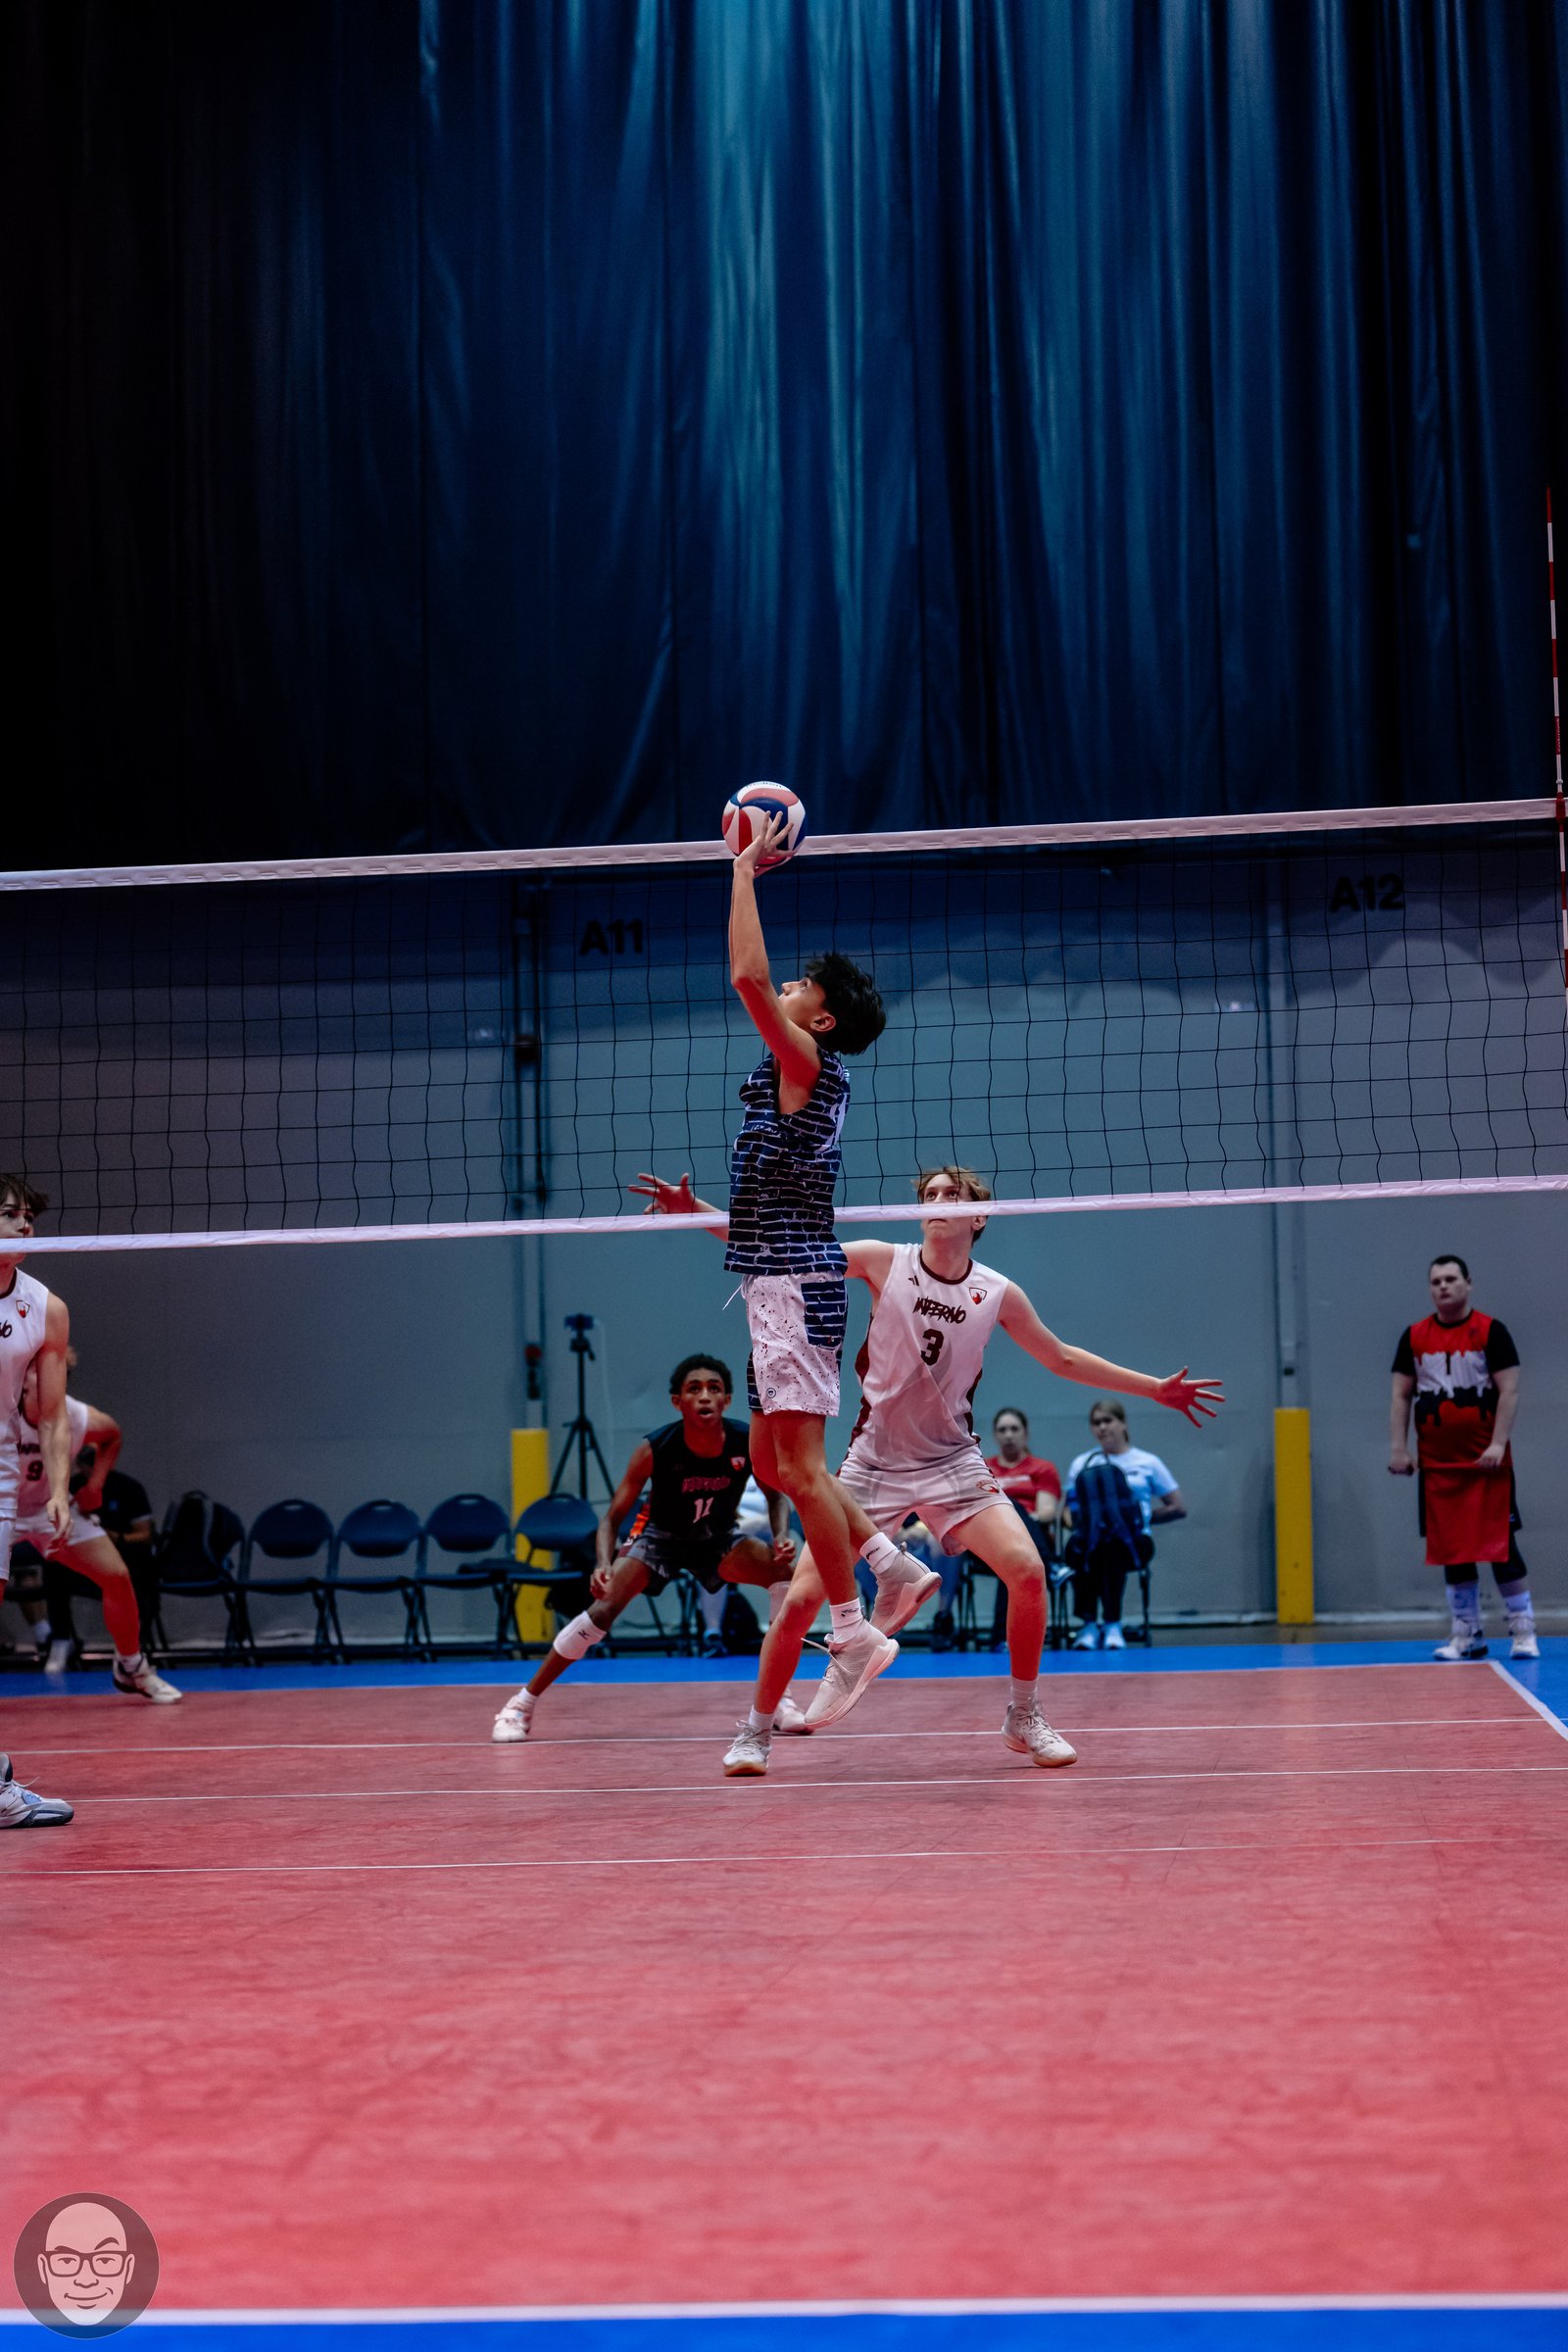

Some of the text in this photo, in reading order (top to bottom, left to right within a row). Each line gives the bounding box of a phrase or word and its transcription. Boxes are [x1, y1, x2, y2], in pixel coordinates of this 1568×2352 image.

[1330, 873, 1404, 912] A12
[579, 919, 643, 956] A11
[921, 1328, 944, 1366] 3
[25, 1459, 44, 1482] 9
